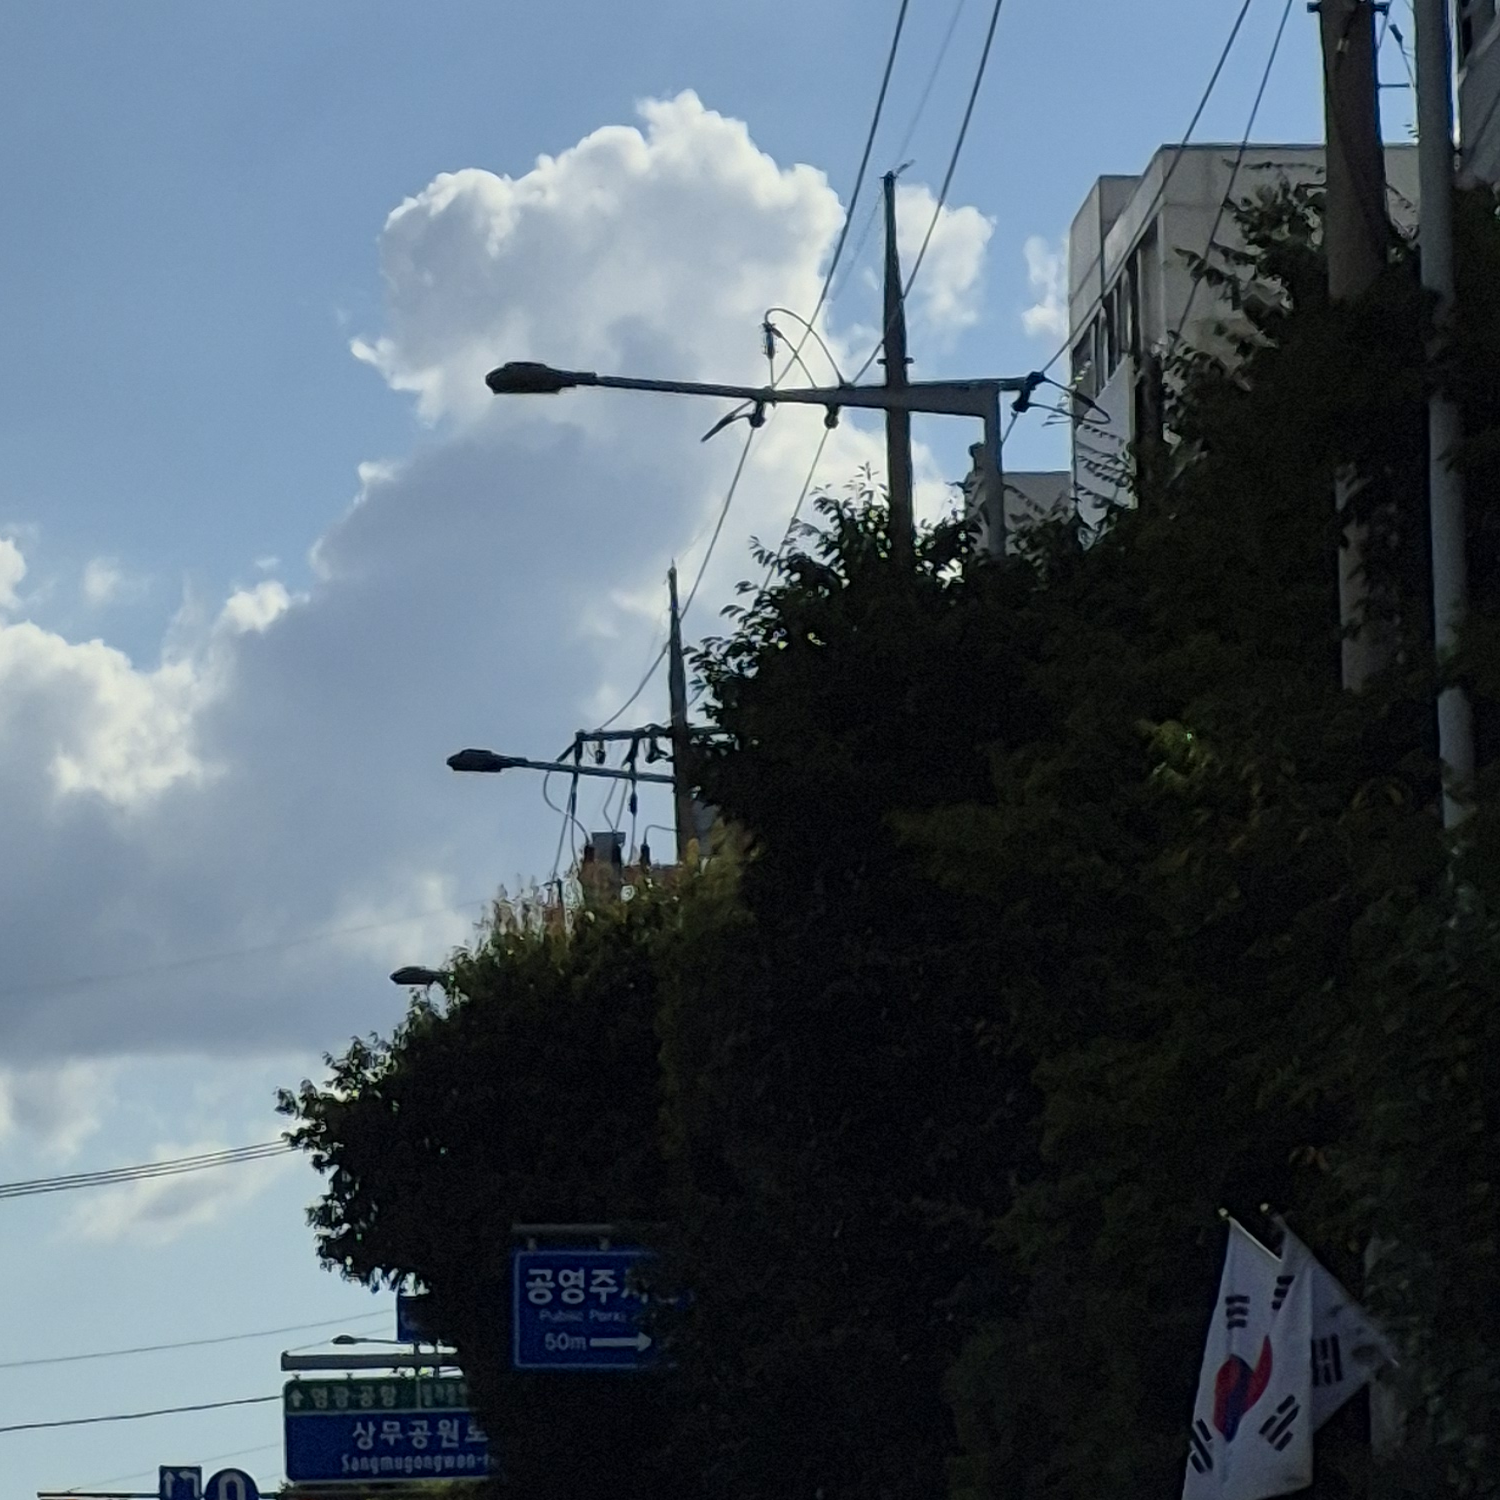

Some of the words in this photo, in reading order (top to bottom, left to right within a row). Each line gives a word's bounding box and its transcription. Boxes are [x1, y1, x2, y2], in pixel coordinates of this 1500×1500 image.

[525, 1267, 681, 1305] 공영주
[544, 1331, 587, 1352] 50m
[352, 1418, 489, 1451] 상무공원로
